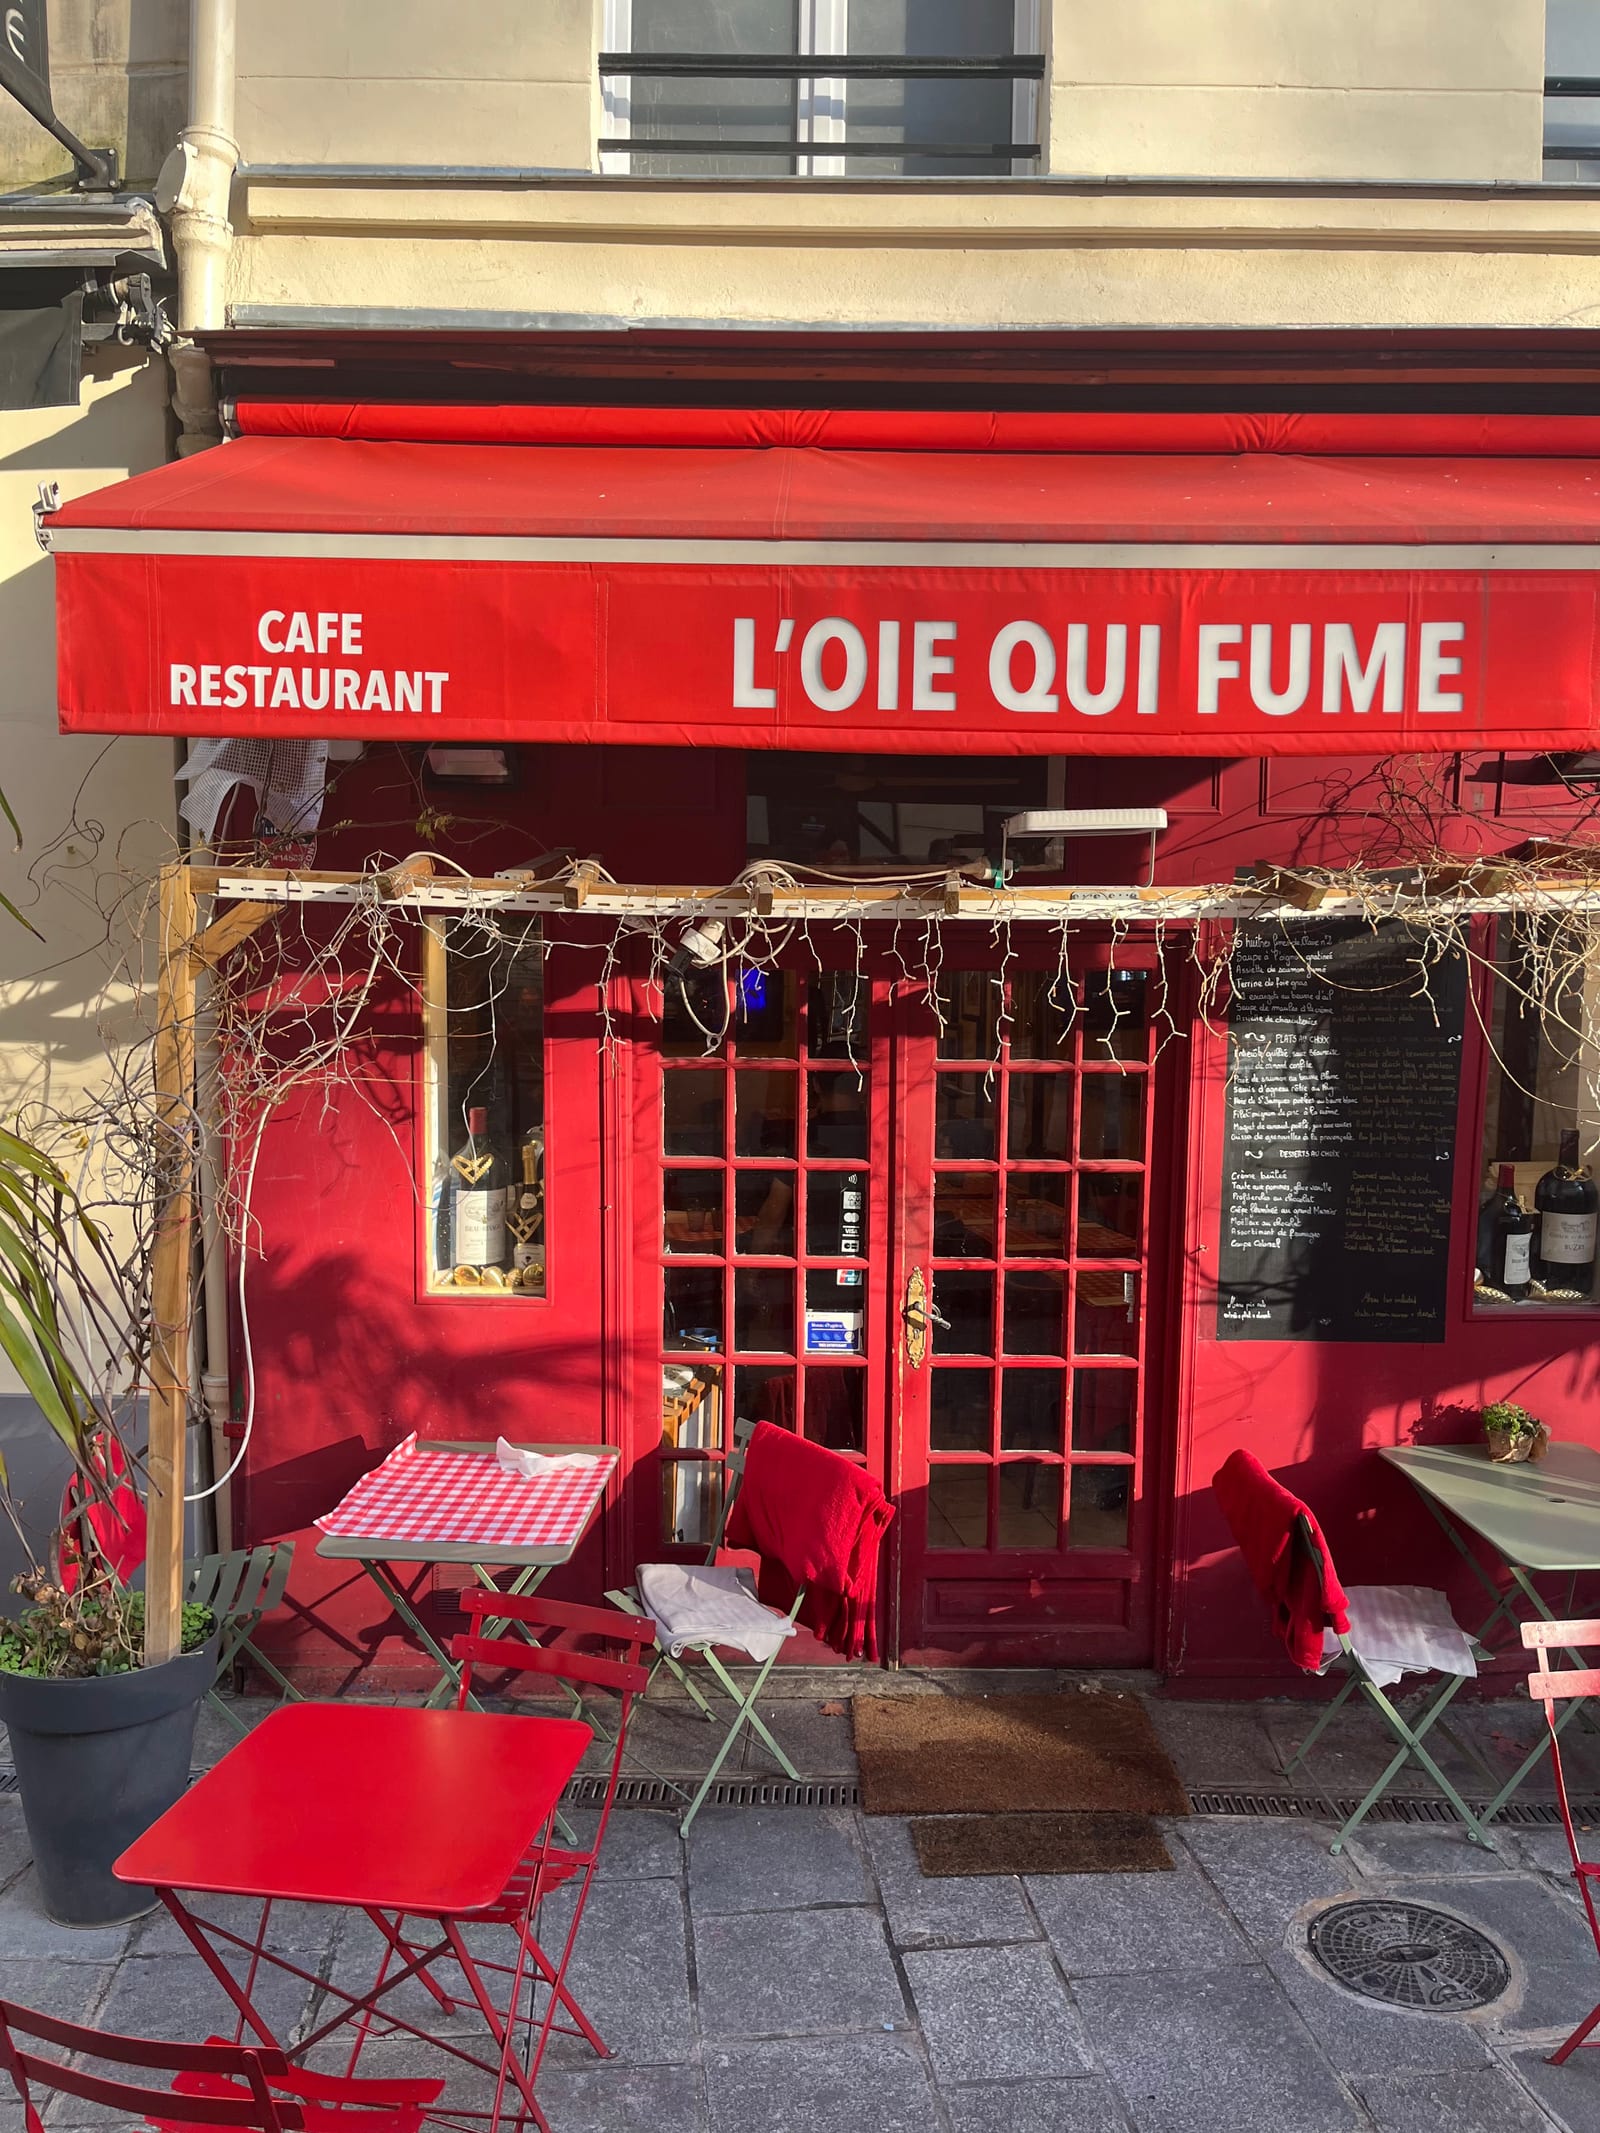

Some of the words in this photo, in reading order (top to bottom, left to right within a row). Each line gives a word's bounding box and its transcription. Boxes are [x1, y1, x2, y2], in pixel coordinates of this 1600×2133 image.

[257, 610, 364, 656] CAFE
[733, 617, 957, 712] L'OIE
[988, 619, 1162, 717] QUI
[1196, 621, 1466, 717] FUME
[170, 663, 450, 714] RESTAURANT
[1236, 978, 1264, 989] Terrine
[1275, 1034, 1298, 1044] PLATS
[1309, 1034, 1330, 1044] CHOIX
[1279, 1149, 1310, 1158] DESSERTS
[1310, 1149, 1320, 1158] AU
[1320, 1150, 1341, 1158] CHOIX
[1231, 1169, 1257, 1181] Crème
[1277, 1227, 1288, 1237] de
